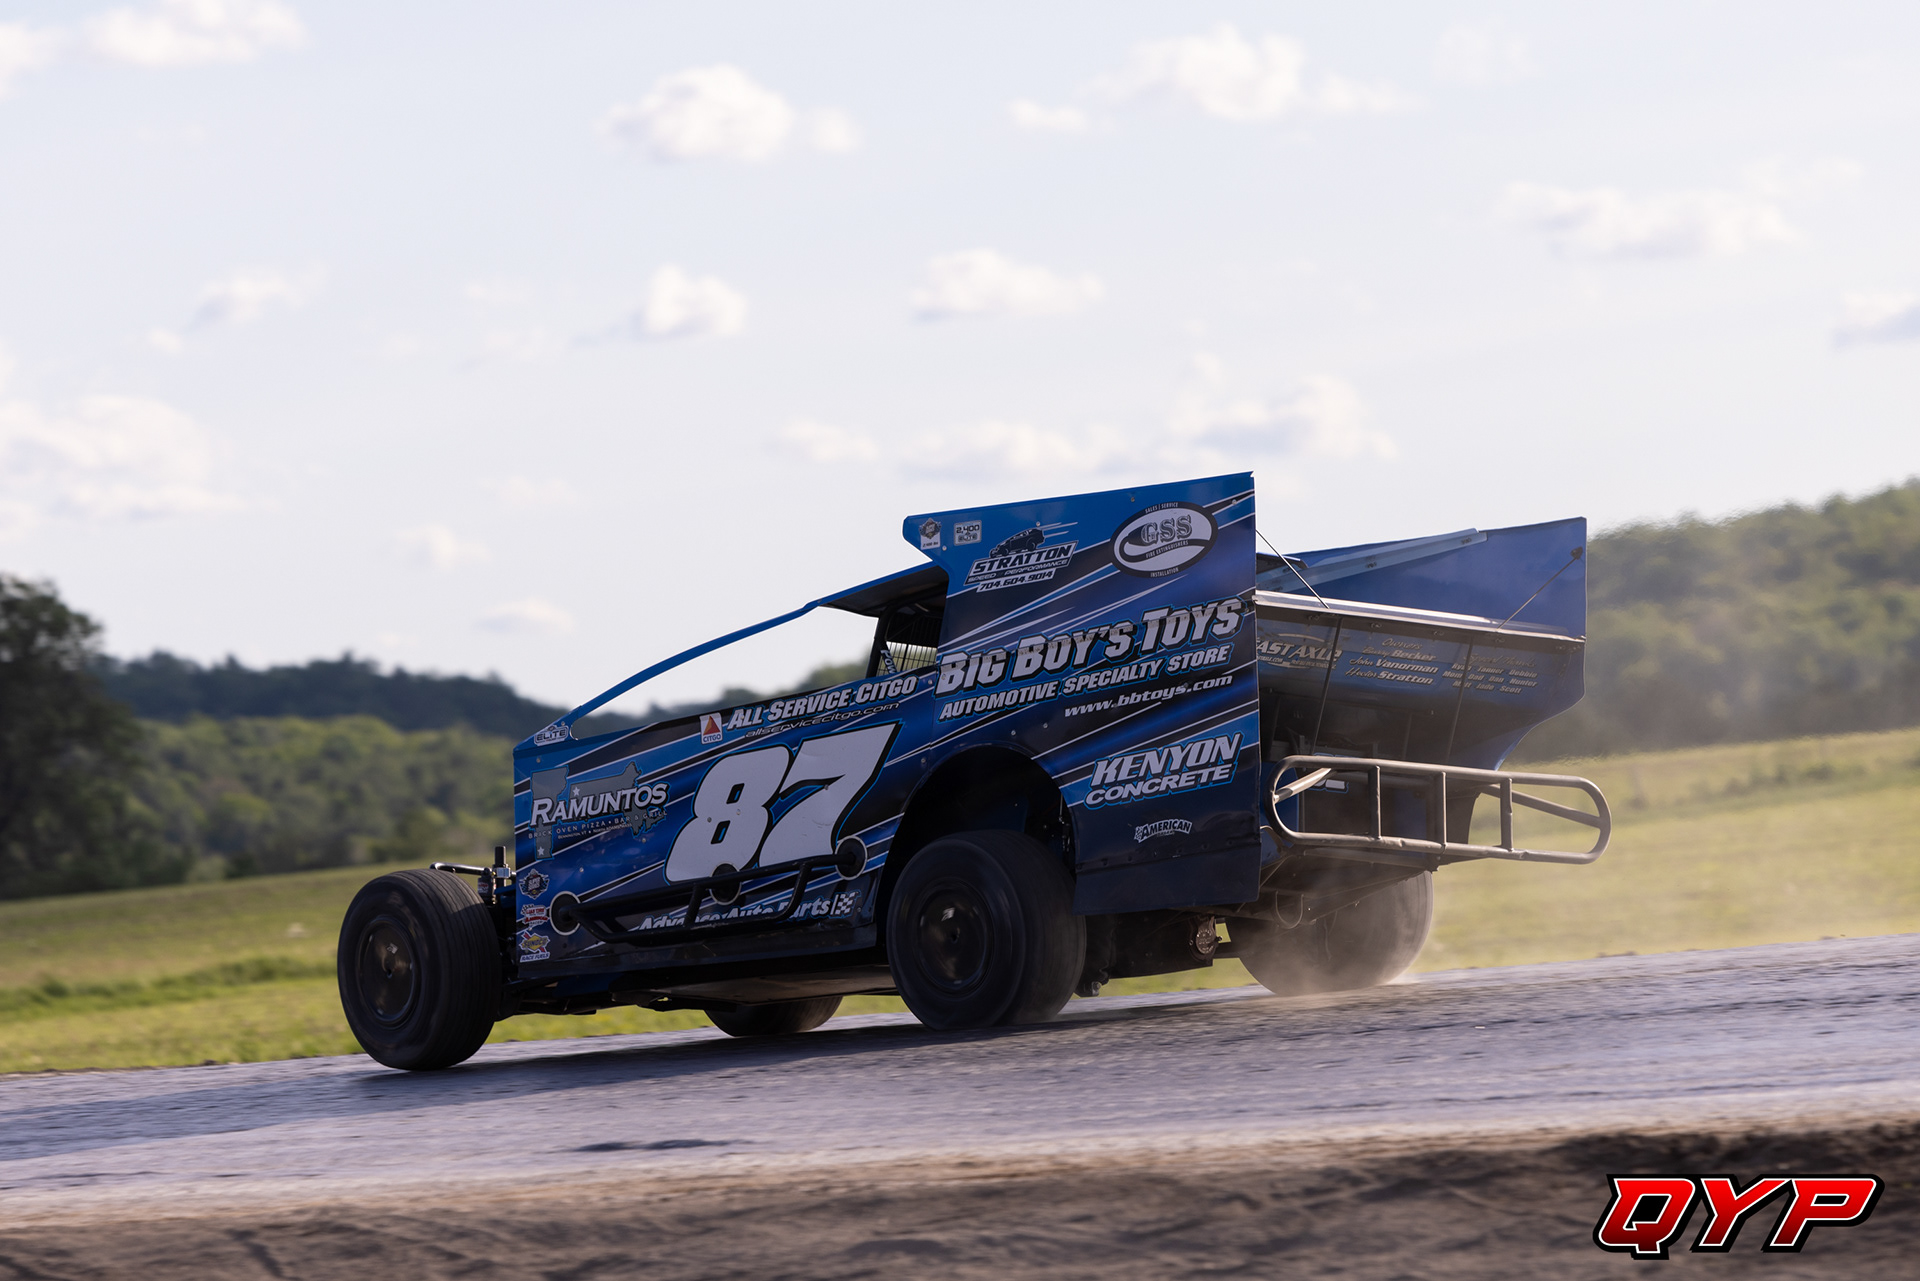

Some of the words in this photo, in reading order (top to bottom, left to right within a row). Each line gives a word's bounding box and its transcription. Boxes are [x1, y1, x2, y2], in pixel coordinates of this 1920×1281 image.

[1145, 504, 1157, 514] SALES
[956, 524, 980, 534] 2,400
[1141, 514, 1192, 545] GSS
[972, 544, 1073, 574] STRATTON
[1146, 550, 1156, 559] FIRE
[1156, 540, 1188, 554] EXTINGUISHERS
[967, 573, 997, 582] SPEED
[1004, 560, 1069, 576] PERFORMANCE
[979, 571, 1053, 591] 704.604.9014
[1150, 567, 1179, 578] INSTALLATION
[935, 650, 1007, 695] BIG
[1012, 621, 1135, 680] BOY'S
[1141, 598, 1243, 651] TOYS
[1382, 638, 1422, 650] Owners
[1349, 656, 1374, 666] John
[1376, 658, 1439, 674] Vanorman
[1391, 649, 1436, 662] Becker
[1377, 670, 1434, 685] Stratton
[1477, 666, 1504, 674] Tanner
[1509, 669, 1538, 678] Debbie
[939, 680, 1058, 720] AUTOMOTIVE
[1063, 660, 1161, 694] SPECIALTY
[1167, 646, 1231, 671] STORE
[1499, 685, 1522, 694] Scott
[1509, 678, 1538, 687] Hunter
[726, 707, 764, 731] ALL
[767, 688, 852, 722] SERVICE
[855, 675, 918, 703] CITGO
[1064, 676, 1233, 717] www.bbtoys.com
[745, 702, 899, 738] allservicecitgo.com
[537, 730, 566, 741] ELITE
[703, 733, 722, 743] CITGO
[1090, 733, 1240, 787] KENYON
[1085, 763, 1233, 805] CONCRETE
[530, 783, 668, 827] RAMUNTOS
[665, 722, 897, 882] 87
[529, 830, 553, 839] BRICK
[556, 825, 578, 834] OVEN
[581, 820, 606, 830] PIZZA
[614, 816, 630, 824] BAR
[643, 810, 668, 819] GRILL
[1140, 820, 1190, 840] AMERICAN
[534, 952, 549, 960] FUELS
